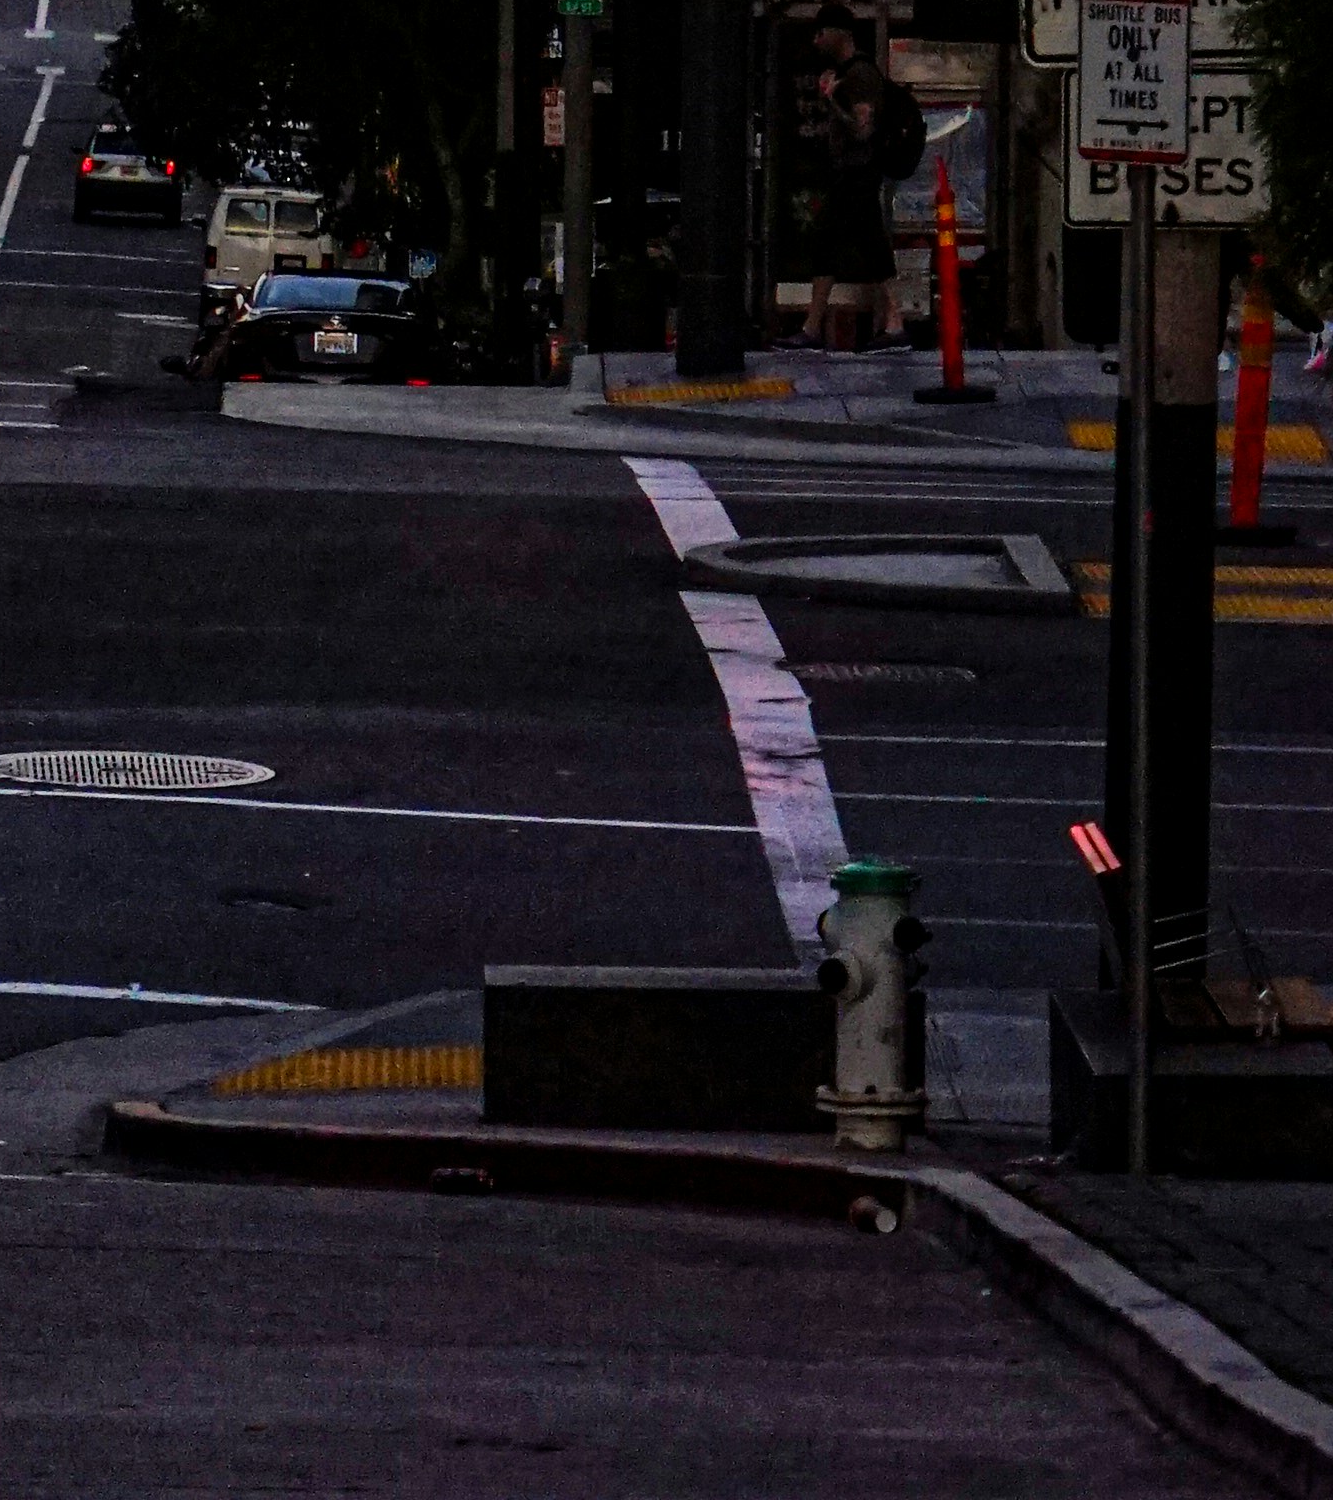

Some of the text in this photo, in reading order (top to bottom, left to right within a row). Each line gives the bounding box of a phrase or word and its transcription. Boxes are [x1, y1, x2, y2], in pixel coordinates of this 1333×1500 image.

[1088, 3, 1181, 25] SHUTTLE BUS
[1108, 25, 1161, 51] ONLY
[1104, 62, 1164, 83] AT ALL
[1109, 88, 1159, 110] TIMES
[1089, 158, 1254, 197] BSES
